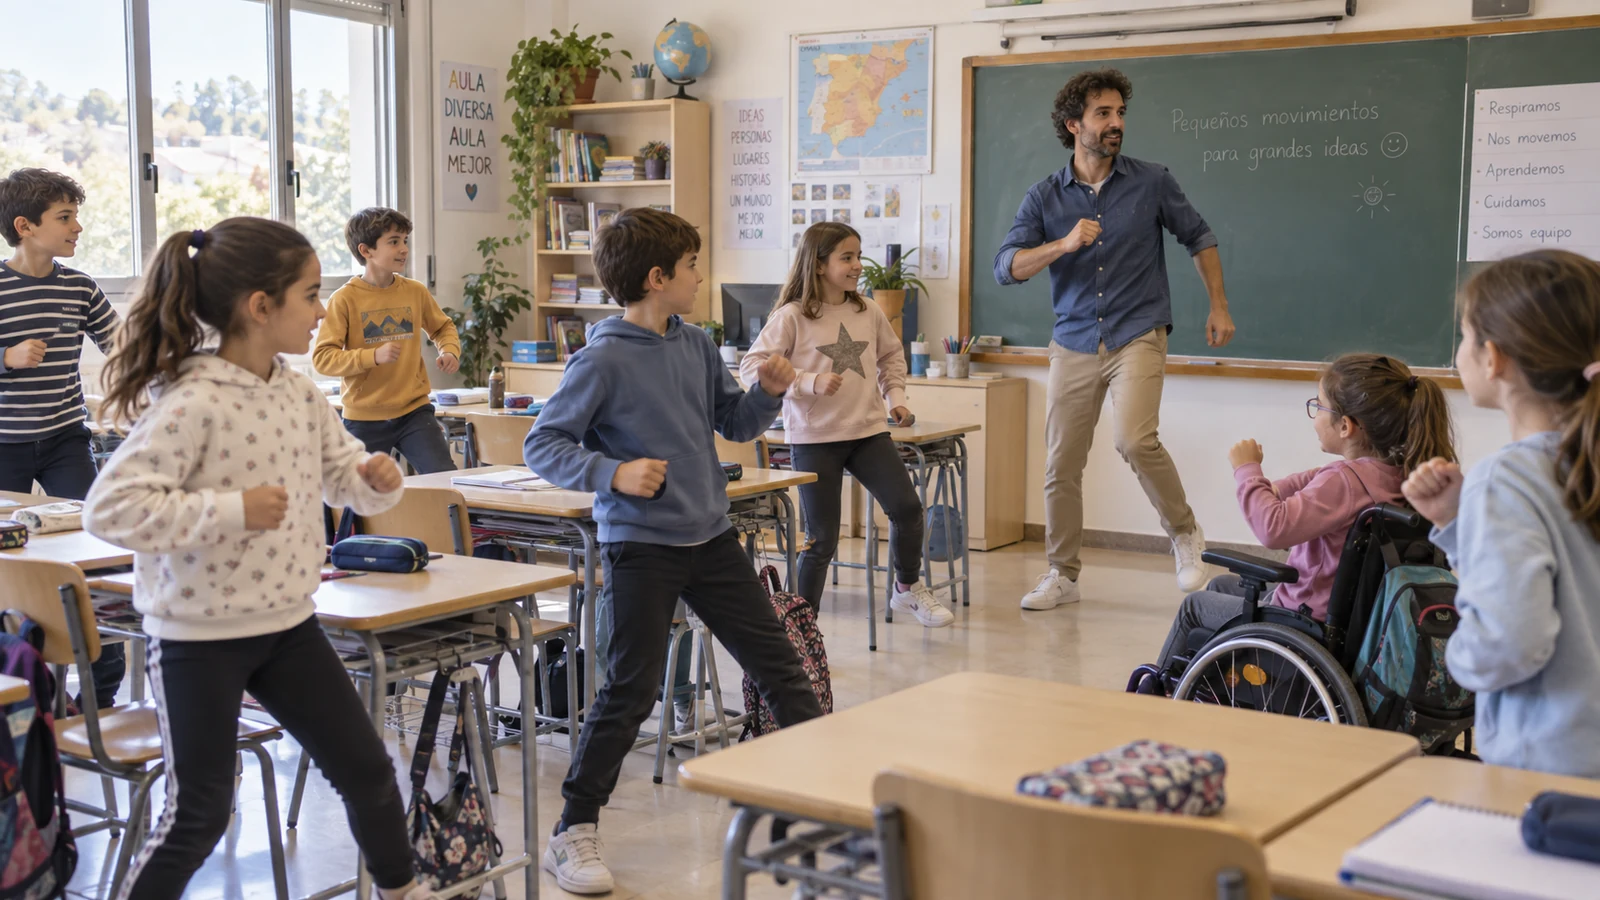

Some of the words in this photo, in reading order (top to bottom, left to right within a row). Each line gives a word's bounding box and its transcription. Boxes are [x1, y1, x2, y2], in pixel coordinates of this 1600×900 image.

[448, 69, 486, 93] AULA
[444, 97, 494, 121] DIVERSA
[738, 108, 765, 123] IDEAS
[1489, 100, 1561, 118] Respiramos
[1171, 108, 1248, 139] Pequeños
[1262, 100, 1379, 125] movimientos
[449, 126, 486, 148] AULA
[731, 129, 772, 144] PERSONAS
[1487, 132, 1511, 146] Nos
[1517, 131, 1577, 144] movemos
[733, 151, 770, 166] LUGARES
[1203, 147, 1239, 172] para
[1247, 138, 1313, 171] grandes
[1324, 136, 1368, 157] ideas
[447, 154, 493, 175] MEJOR
[1485, 162, 1565, 181] Aprendemos
[731, 173, 771, 187] HISTORIAS
[730, 194, 741, 207] UN
[744, 193, 772, 207] MUNDO
[1483, 194, 1546, 209] Cuidamos
[737, 212, 765, 225] MEJOR
[1482, 225, 1523, 240] Somos
[1530, 227, 1572, 243] equipo
